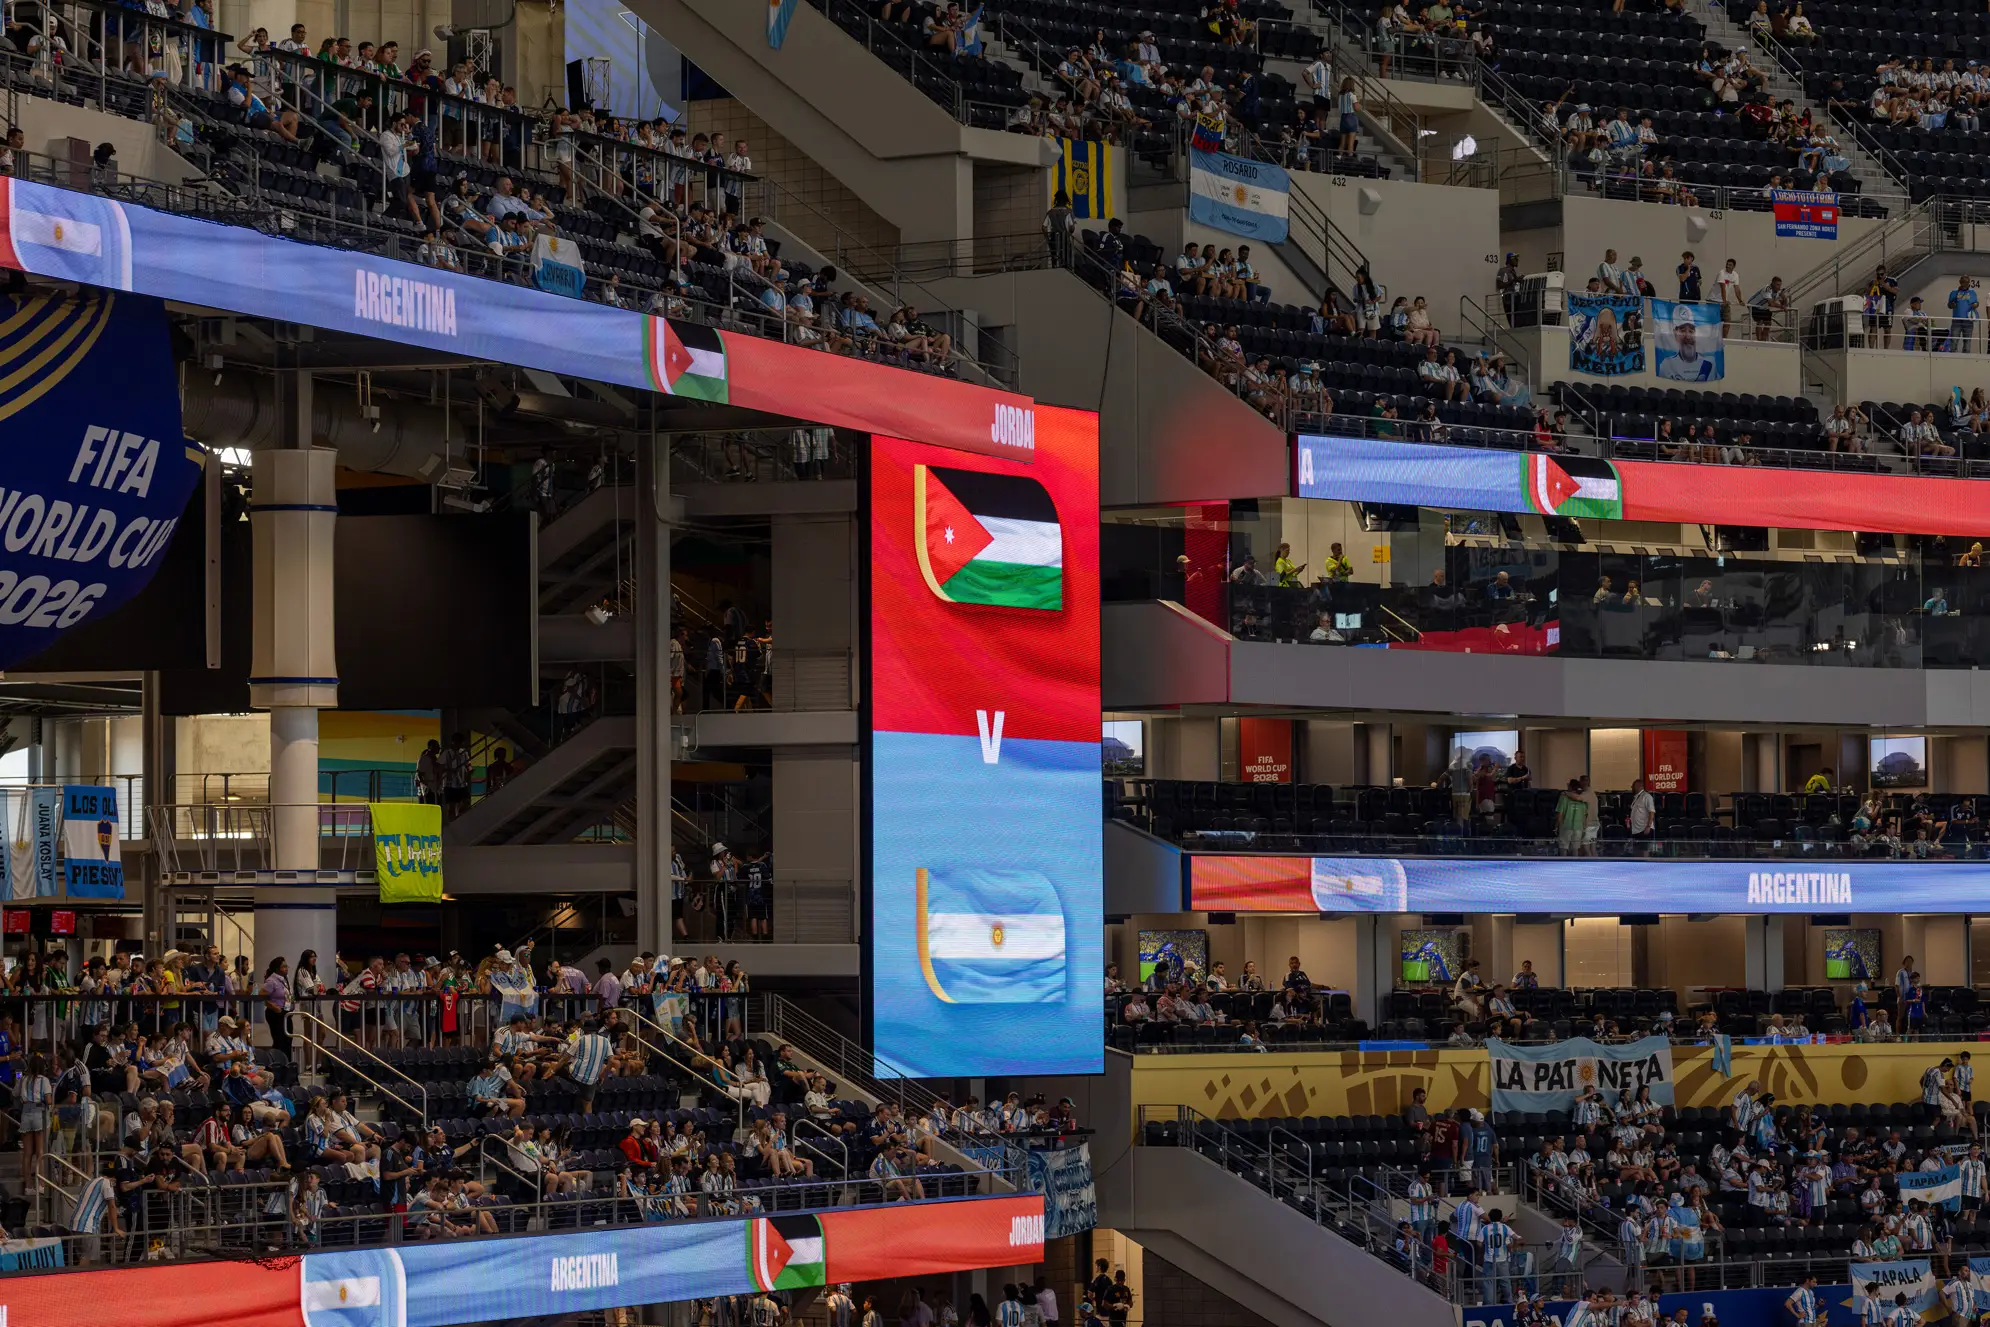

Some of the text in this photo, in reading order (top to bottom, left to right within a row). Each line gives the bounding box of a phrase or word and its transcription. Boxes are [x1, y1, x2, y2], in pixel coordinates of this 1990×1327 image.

[1223, 160, 1258, 179] ROSARIO
[1332, 177, 1347, 187] 432
[1709, 211, 1723, 220] 433
[1485, 254, 1499, 264] 433
[355, 269, 457, 338] ARGENTINA
[1571, 295, 1640, 308] DEPORTIVO
[1572, 350, 1643, 375] MERLO
[68, 424, 160, 499] FIFA
[108, 516, 180, 569] CUP
[976, 709, 1006, 765] V
[1257, 756, 1274, 764] FIFA
[1659, 764, 1673, 772] FIFA
[1245, 764, 1287, 774] WORLD CUP
[1648, 772, 1684, 782] WORLD CUP
[1253, 774, 1279, 782] 2026
[1655, 781, 1677, 790] 2026
[71, 795, 98, 815] LOS
[39, 803, 53, 881] JUANA KOSLAY
[1747, 873, 1853, 904] ARGENTINA
[1495, 1059, 1527, 1091] LA
[1434, 1125, 1448, 1144] 15
[1476, 1136, 1488, 1153] 10
[1907, 1174, 1948, 1188] ZAPALA
[1490, 1233, 1502, 1248] 10
[551, 1252, 619, 1292] ARGENTINA
[1872, 1267, 1922, 1287] ZAPALA
[1009, 1311, 1019, 1326] 10
